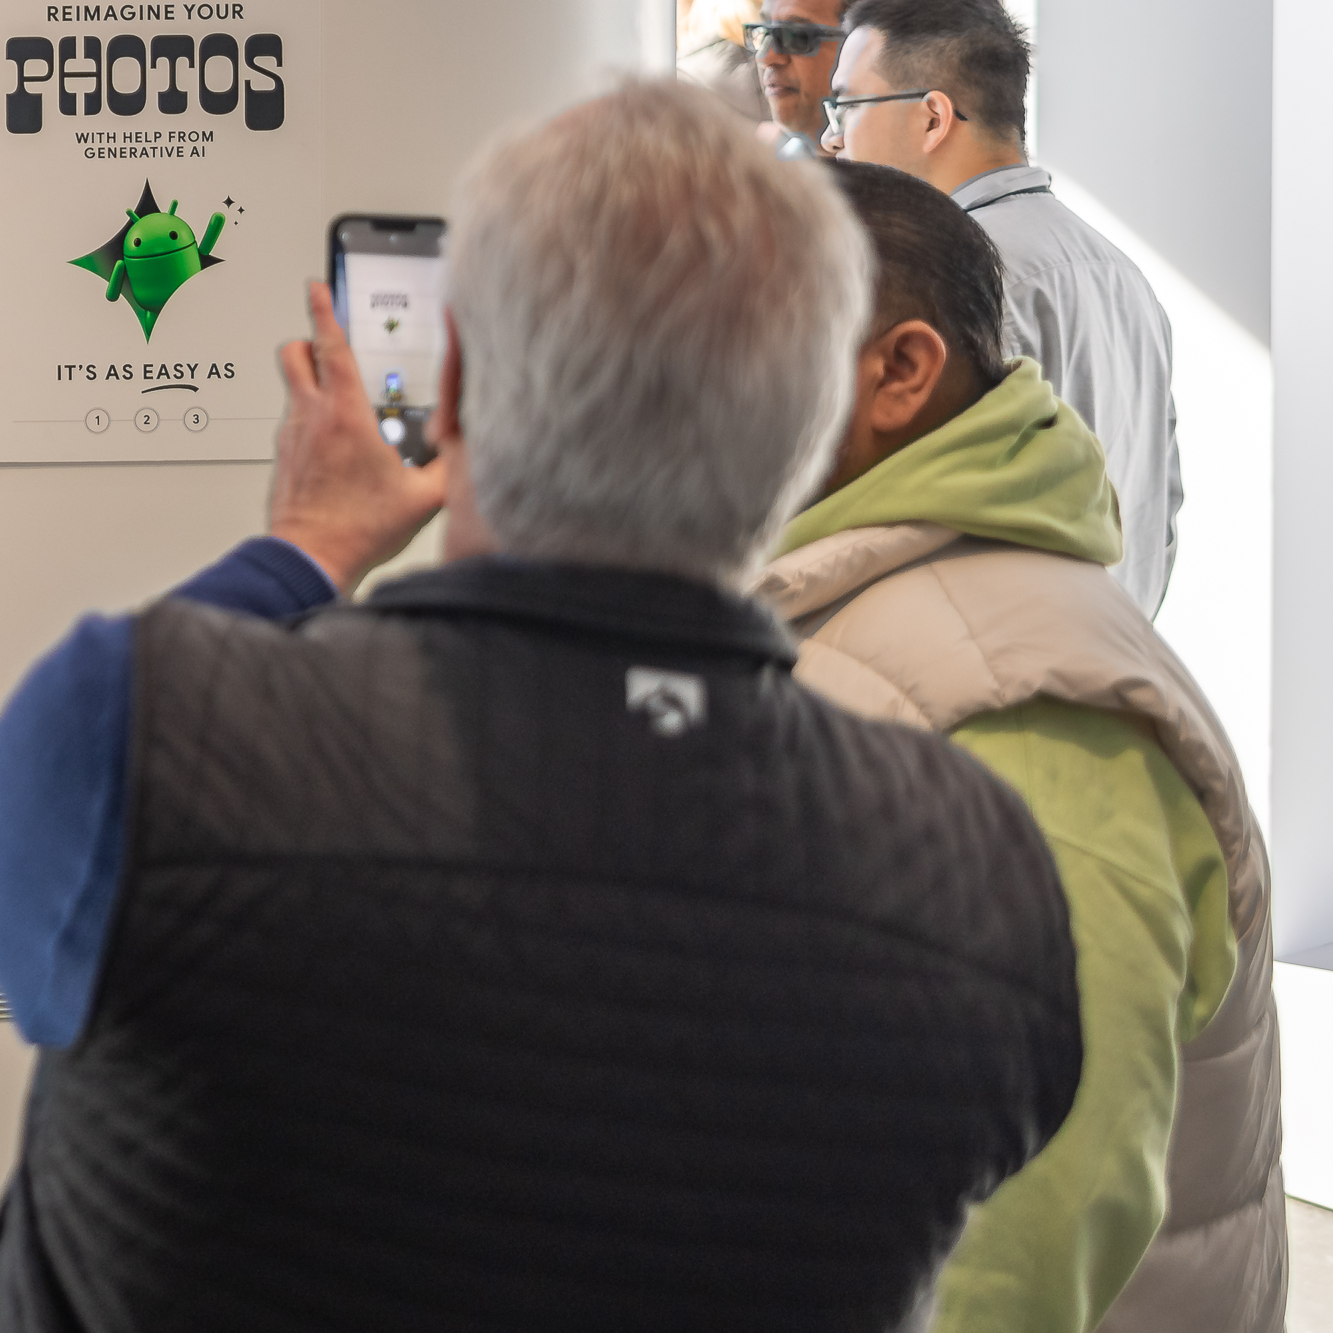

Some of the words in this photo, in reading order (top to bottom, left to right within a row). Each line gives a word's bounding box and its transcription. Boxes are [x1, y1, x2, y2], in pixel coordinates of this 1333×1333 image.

[47, 4, 175, 22] REIMAGINE
[182, 3, 244, 21] YOUR
[5, 32, 285, 134] PHOTOS
[75, 131, 117, 144] WITH
[123, 131, 163, 144] HELP
[168, 130, 214, 143] FROM
[84, 146, 185, 159] GENERATIVE
[189, 145, 206, 158] AI
[104, 363, 134, 381] AS
[142, 363, 200, 381] EASY
[206, 362, 236, 380] AS
[95, 415, 101, 426] 1
[143, 414, 151, 425] 2
[192, 413, 200, 425] 3
